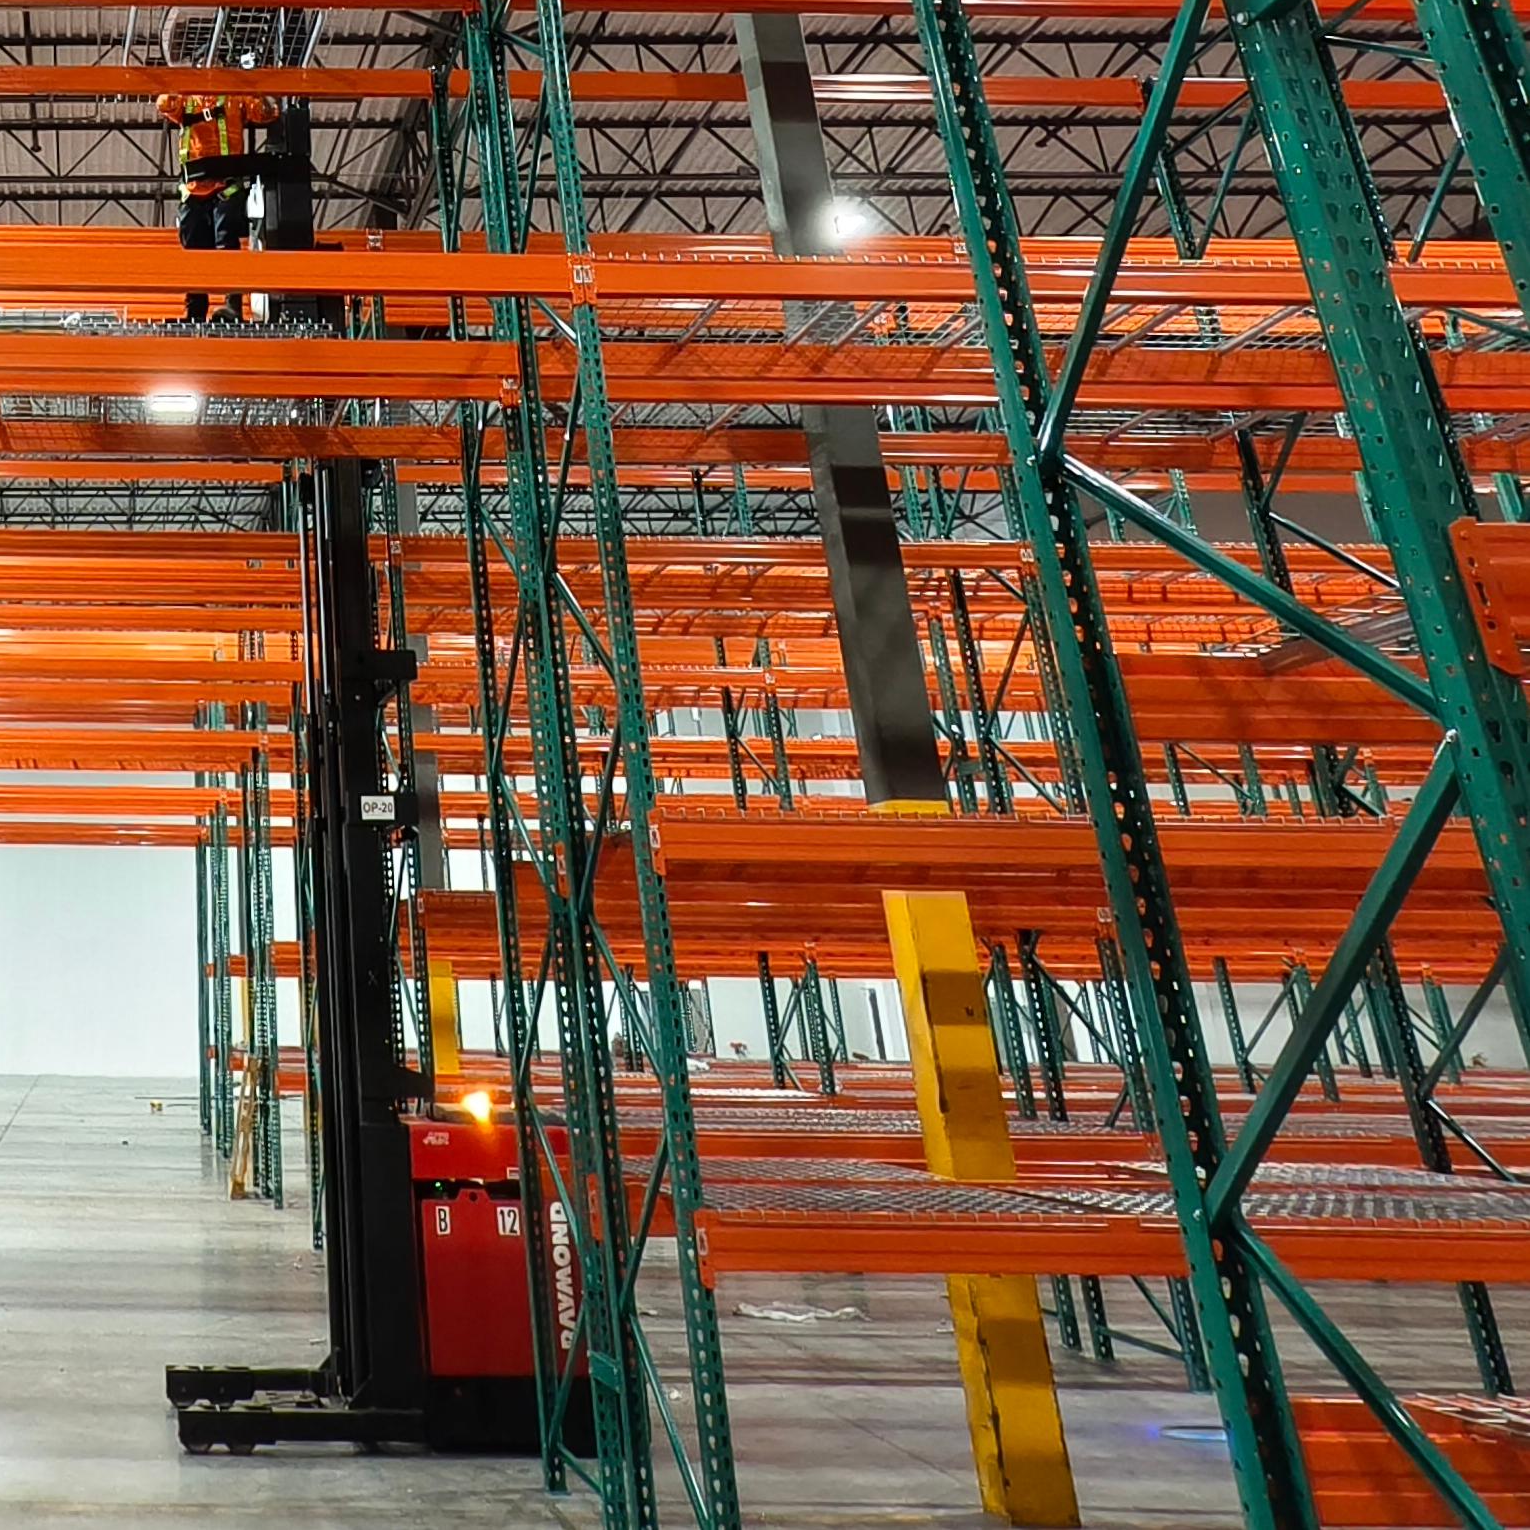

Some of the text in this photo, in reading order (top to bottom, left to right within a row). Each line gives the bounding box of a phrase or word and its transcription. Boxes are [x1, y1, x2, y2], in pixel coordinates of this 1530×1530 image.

[363, 801, 393, 814] OP-20
[438, 1208, 518, 1234] B 12
